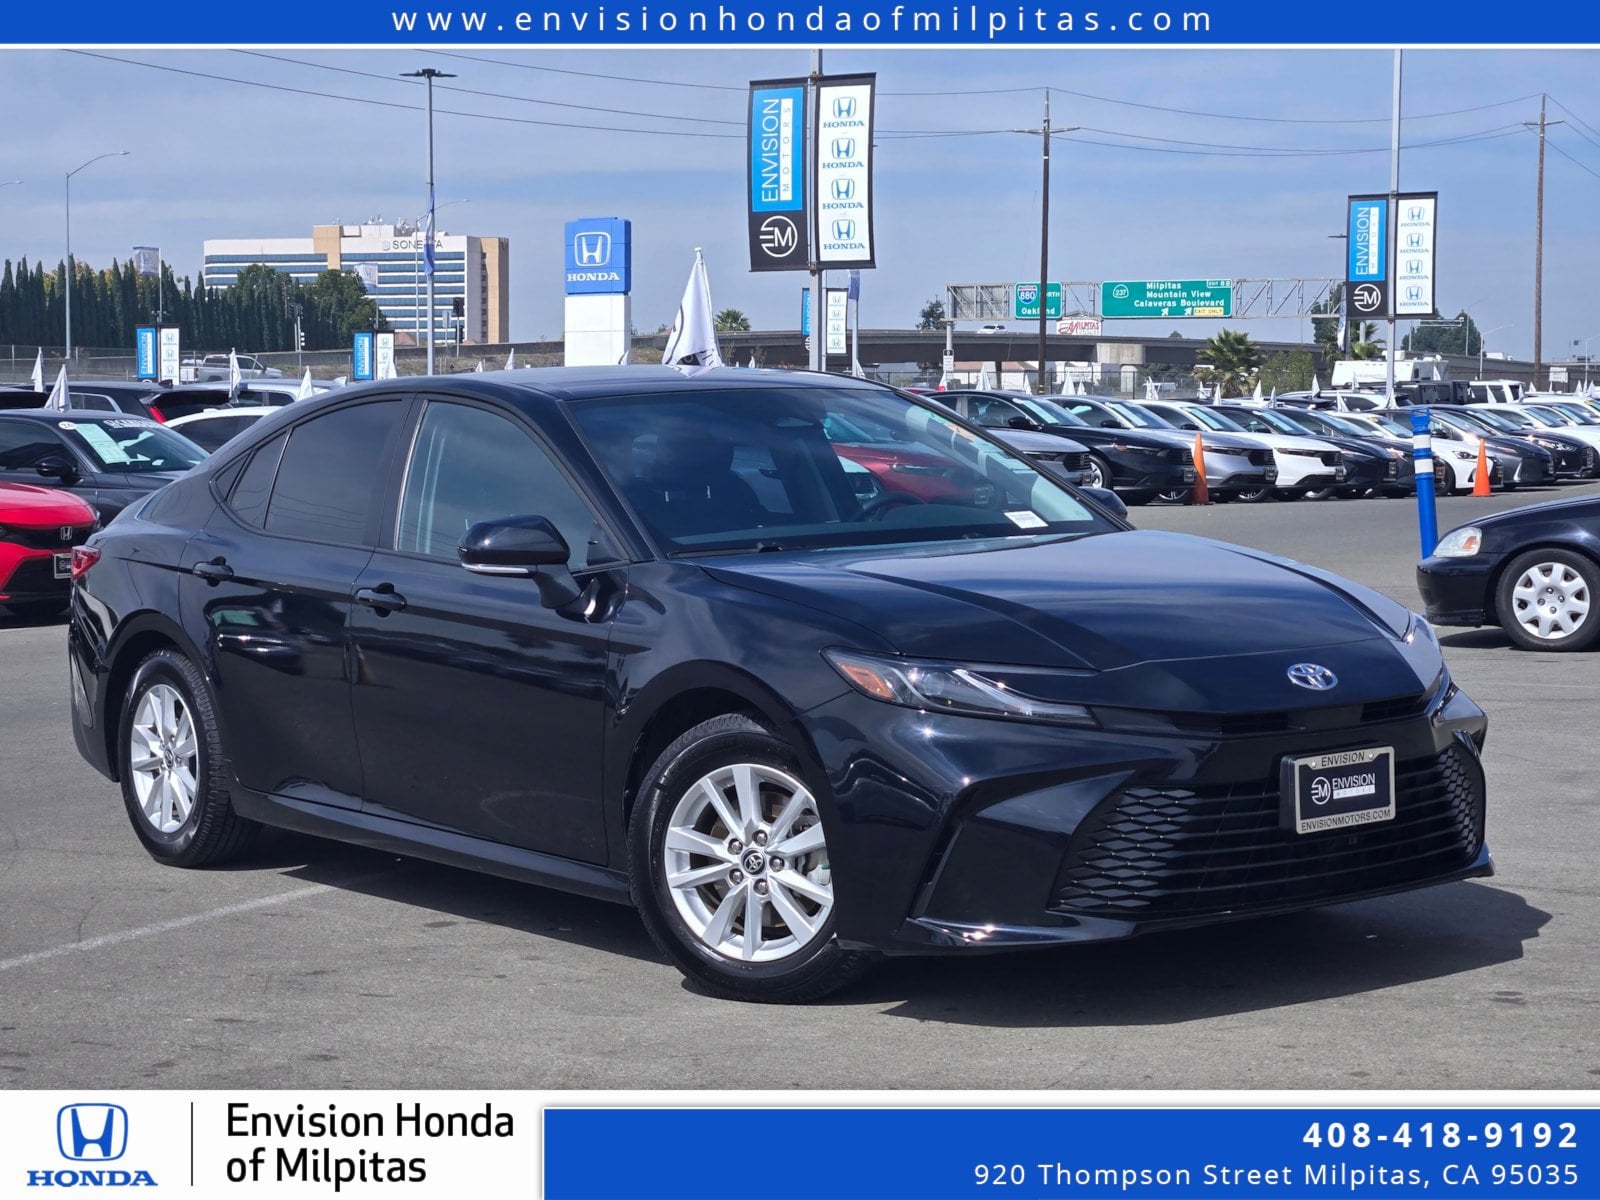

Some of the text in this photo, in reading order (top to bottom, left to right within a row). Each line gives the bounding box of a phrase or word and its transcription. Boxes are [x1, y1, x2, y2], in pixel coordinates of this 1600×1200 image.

[823, 120, 865, 129] HONDA
[762, 98, 780, 202] ENVISION
[783, 107, 791, 192] MOTORS
[822, 161, 864, 169] HONDA
[822, 202, 864, 210] HONDA
[392, 240, 443, 249] SONEA
[1356, 207, 1370, 275] ENVISION
[567, 272, 620, 282] HONDA
[1146, 282, 1182, 291] Milpitas
[1020, 291, 1035, 299] 880
[1191, 290, 1212, 298] View
[1180, 299, 1225, 307] Boulevard
[1021, 307, 1056, 315] Oaklnd
[1321, 752, 1365, 767] ENVISION
[1332, 773, 1376, 790] ENVISION
[1301, 809, 1391, 832] ENVISIONMOTORS.COM
